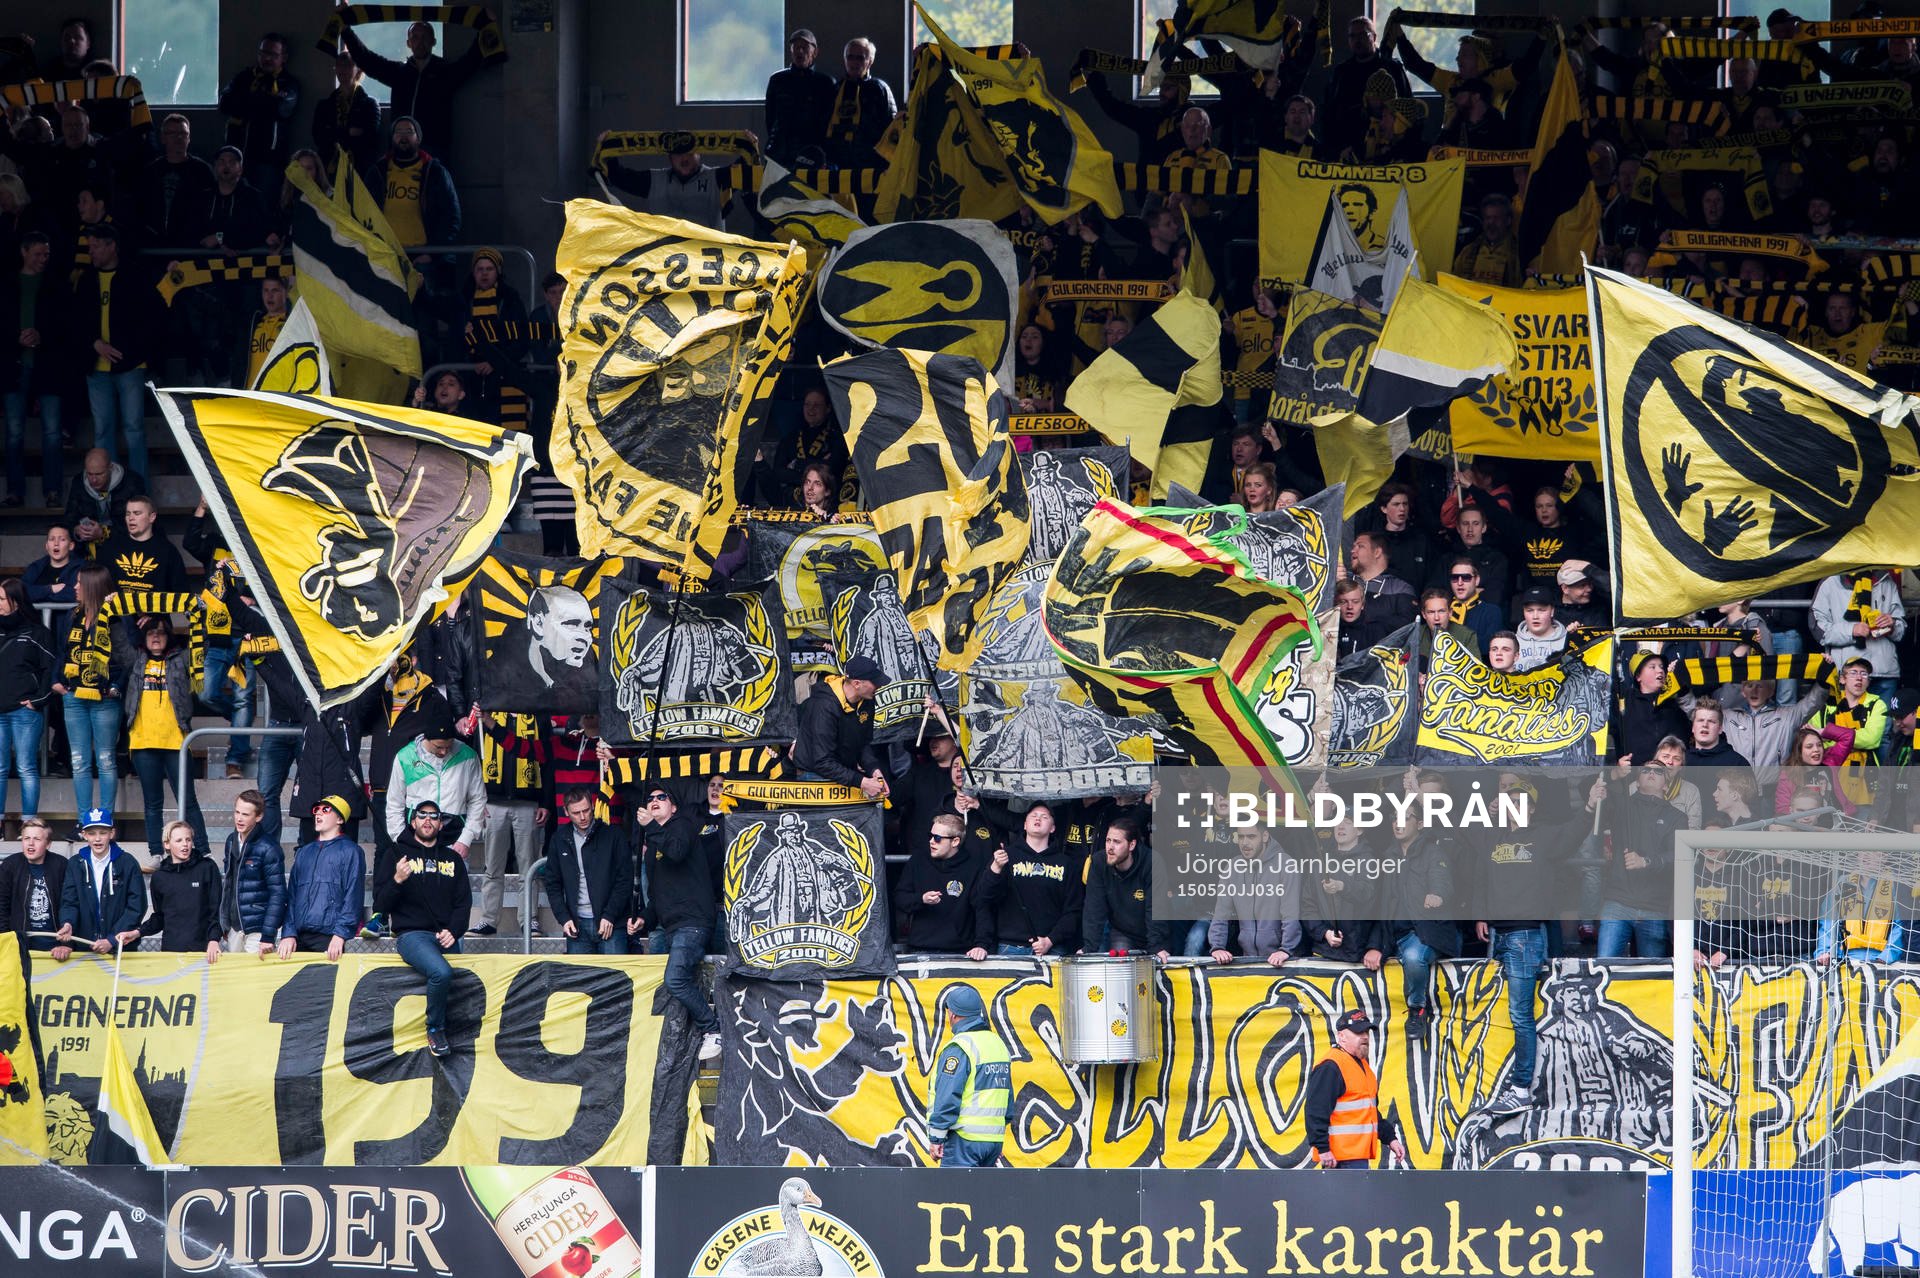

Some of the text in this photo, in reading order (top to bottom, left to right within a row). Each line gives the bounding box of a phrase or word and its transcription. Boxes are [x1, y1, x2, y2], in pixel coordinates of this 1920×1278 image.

[1298, 161, 1427, 183] NUMMER 8
[1687, 233, 1789, 251] GULIGANERNA 1991
[1052, 284, 1150, 297] GULIGANERNA 1991
[1015, 417, 1092, 431] ELFSBOR
[692, 704, 759, 733] FANATICS
[1422, 674, 1590, 744] Fanatics
[1485, 743, 1521, 756] 2001
[747, 785, 851, 800] GULIGANERNA 1991
[744, 927, 858, 957] YELLOW FANATICS
[777, 948, 825, 961] 2001
[60, 1036, 91, 1052] 1991
[512, 1186, 578, 1236] HERRLJUNGA
[167, 1183, 454, 1276] CIDER
[523, 1201, 595, 1260] CIDER
[916, 1199, 1604, 1275] En stark karaktär
[703, 1214, 872, 1273] GÄSENE MEJERI
